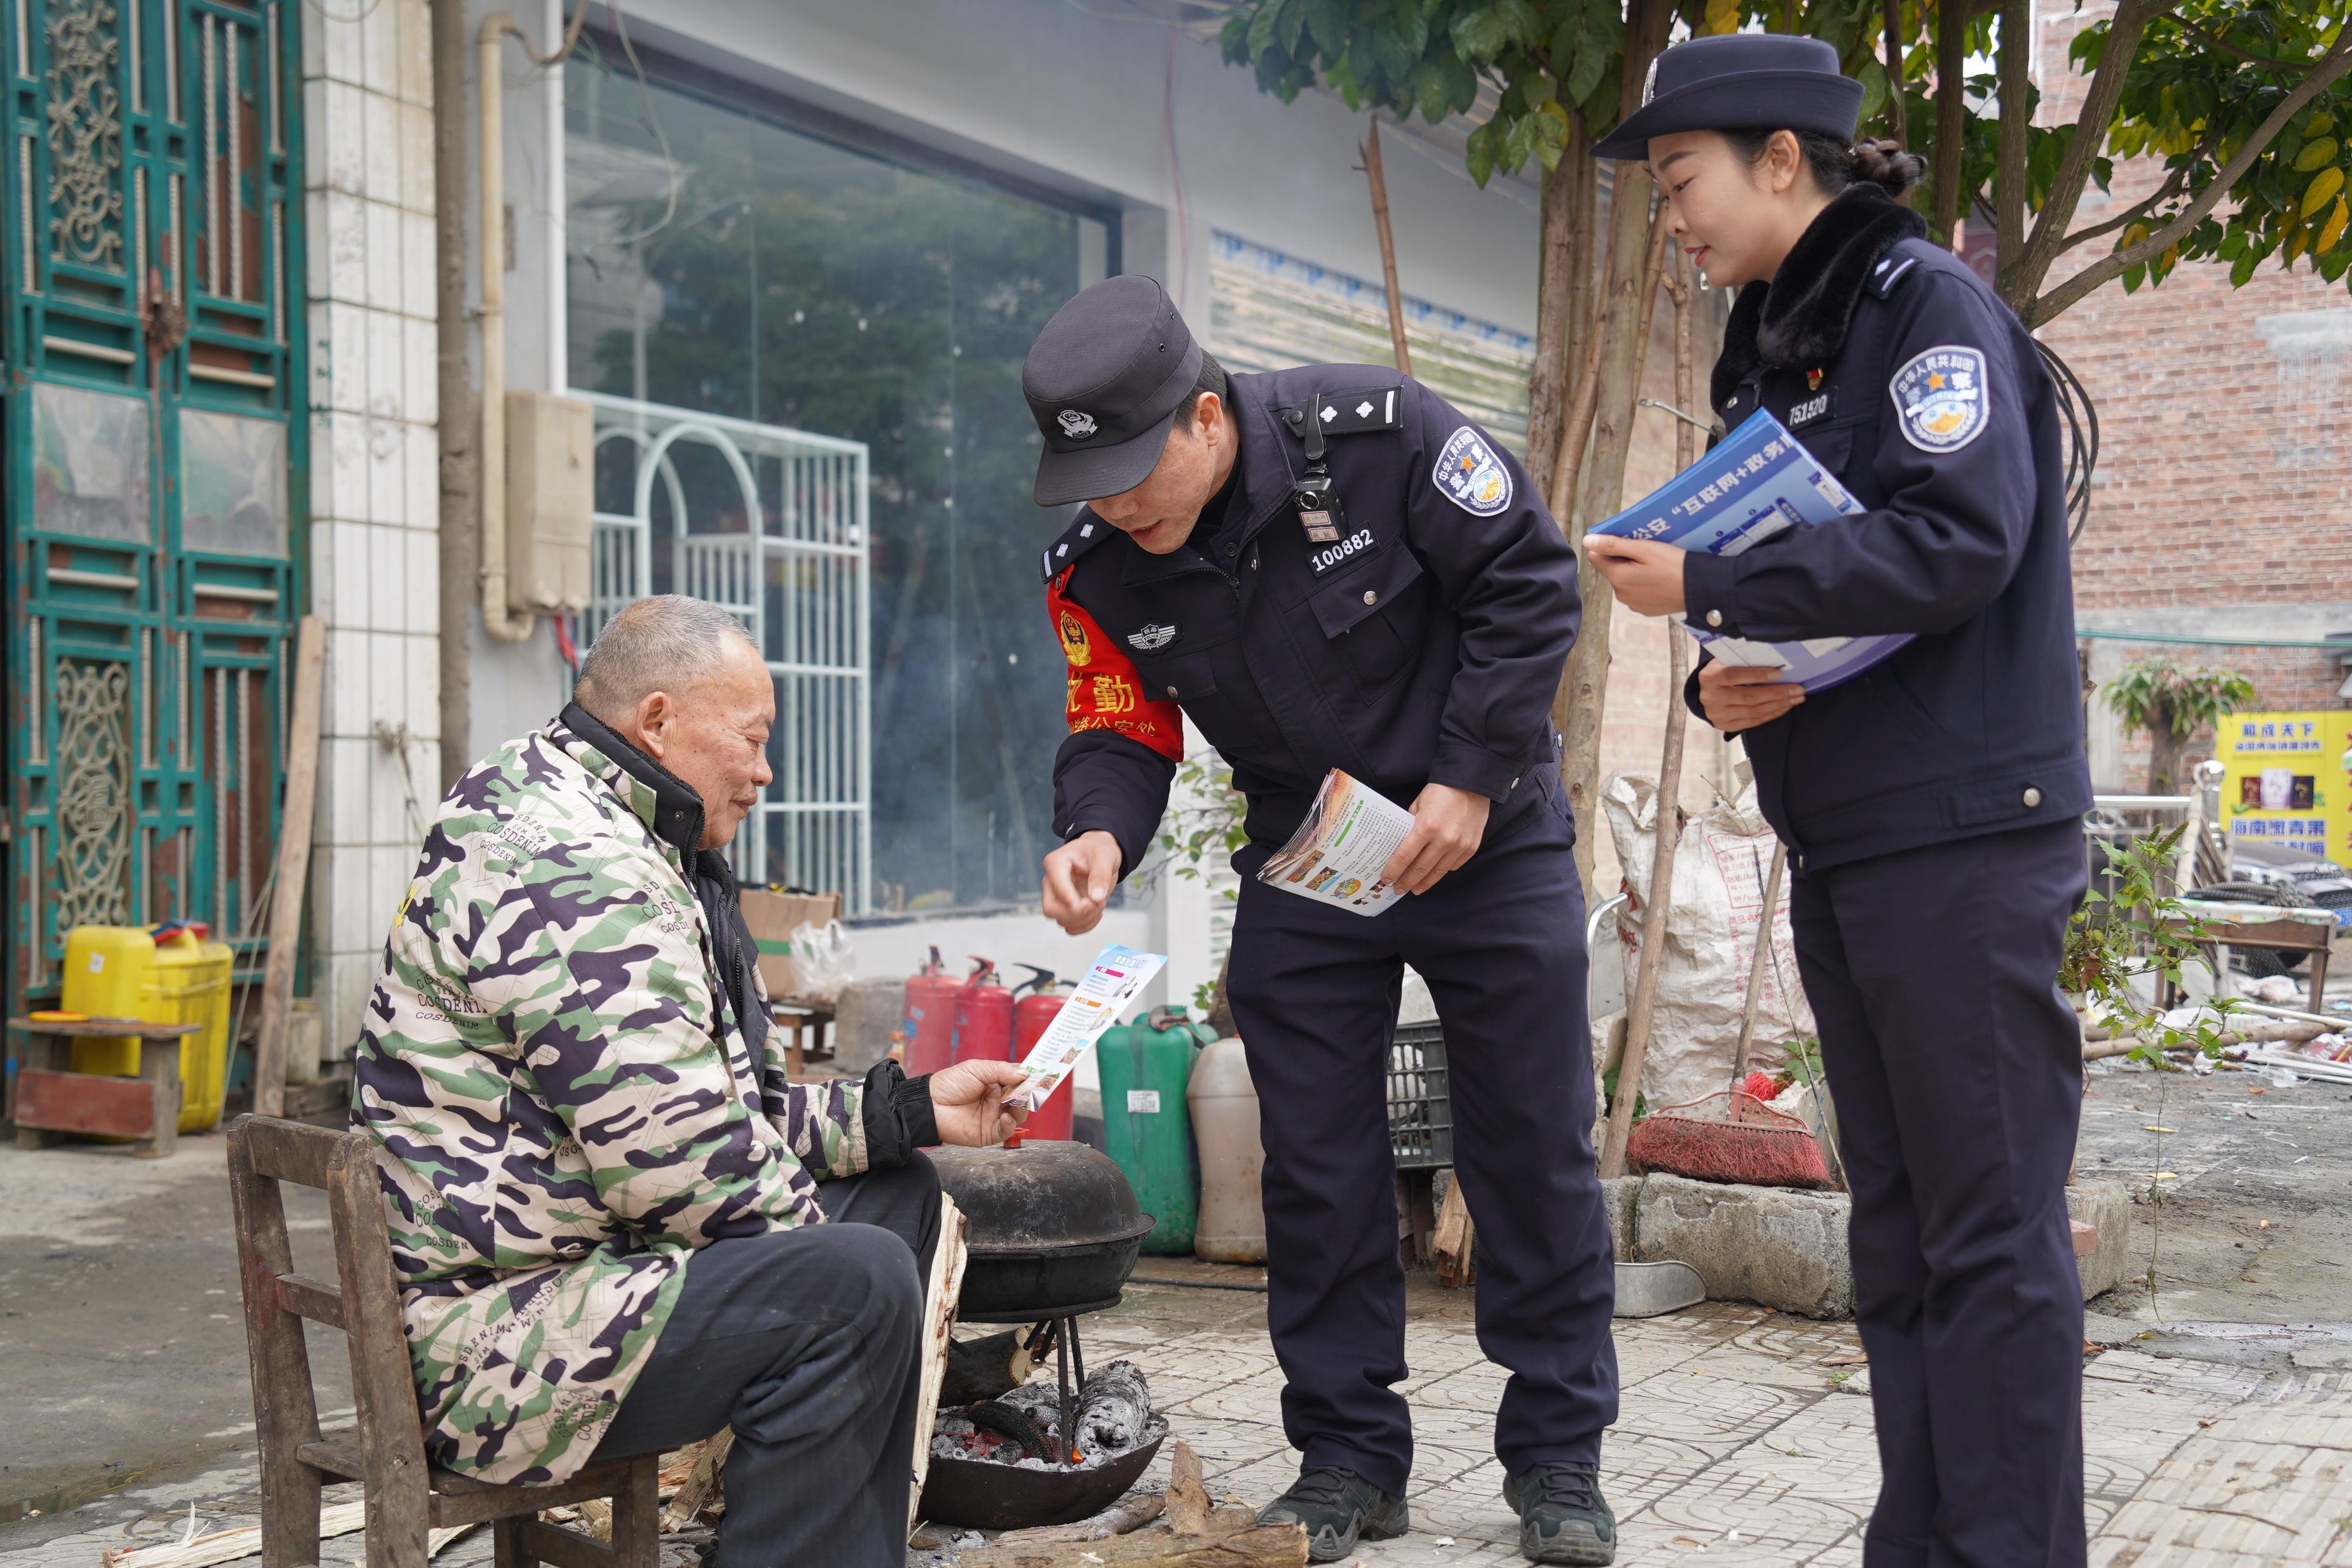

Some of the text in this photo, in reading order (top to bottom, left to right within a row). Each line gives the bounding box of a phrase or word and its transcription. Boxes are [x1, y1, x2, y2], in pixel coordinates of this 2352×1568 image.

[1898, 355, 1974, 393] 中华人民共和国
[1438, 432, 1475, 481] 中华人民共和国
[1312, 529, 1374, 571] 100882
[2242, 722, 2314, 737] 和成天下
[487, 822, 544, 857] COSDENIM
[516, 814, 547, 843] SDENIM
[480, 840, 519, 866] COSDENIM
[416, 1011, 479, 1030] COSDENIM
[427, 1236, 468, 1250] COSDEN
